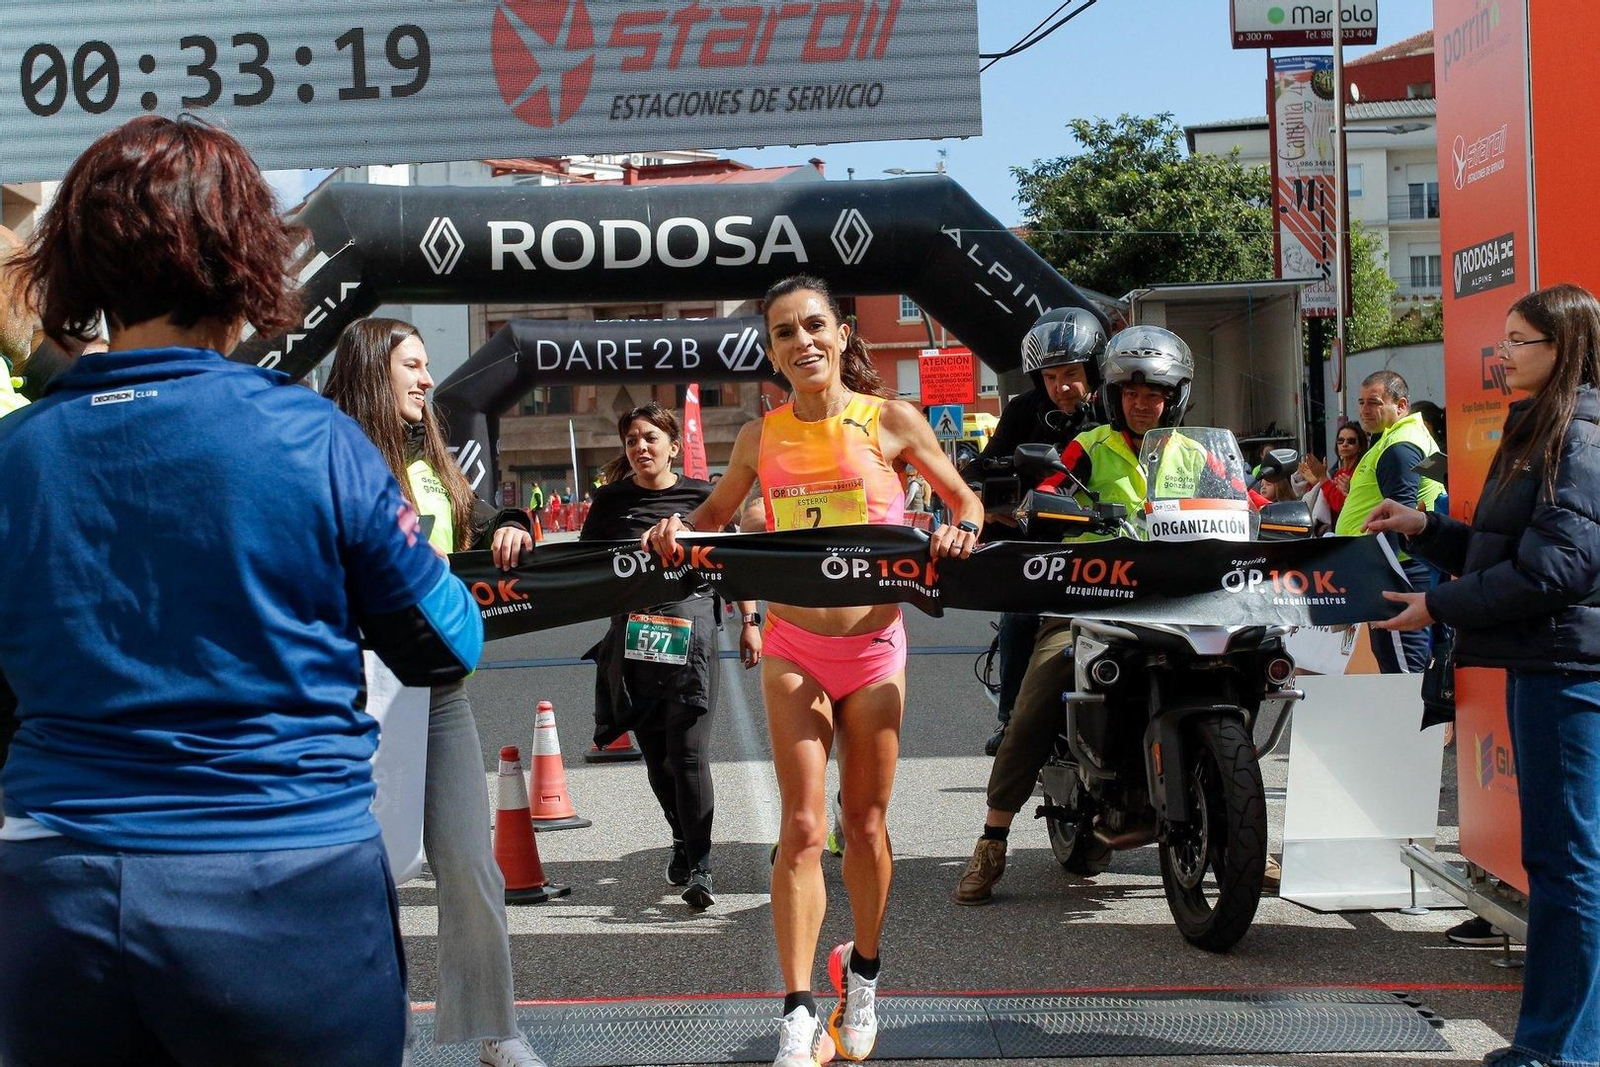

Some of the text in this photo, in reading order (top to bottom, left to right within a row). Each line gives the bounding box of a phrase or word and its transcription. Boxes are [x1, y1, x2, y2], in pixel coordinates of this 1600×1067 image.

[1246, 33, 1262, 41] 300
[1305, 31, 1319, 39] Tel.
[1357, 29, 1372, 38] 404
[20, 24, 432, 117] 00:33:19
[610, 81, 885, 121] ESTACIONES DE SERVICIO
[487, 215, 809, 270] RODOSA
[940, 225, 1052, 317] ALPIN
[1463, 241, 1500, 274] RODOSA
[1471, 273, 1492, 286] ALPINE
[536, 337, 701, 371] DARE 2B
[922, 356, 970, 366] ATENCIÓN
[135, 390, 158, 398] CLUB
[1152, 517, 1246, 537] ORGANIZACIÓN
[1023, 555, 1138, 587] OP. 10K.
[1221, 567, 1347, 594] OP. 10K.
[637, 630, 672, 653] 527
